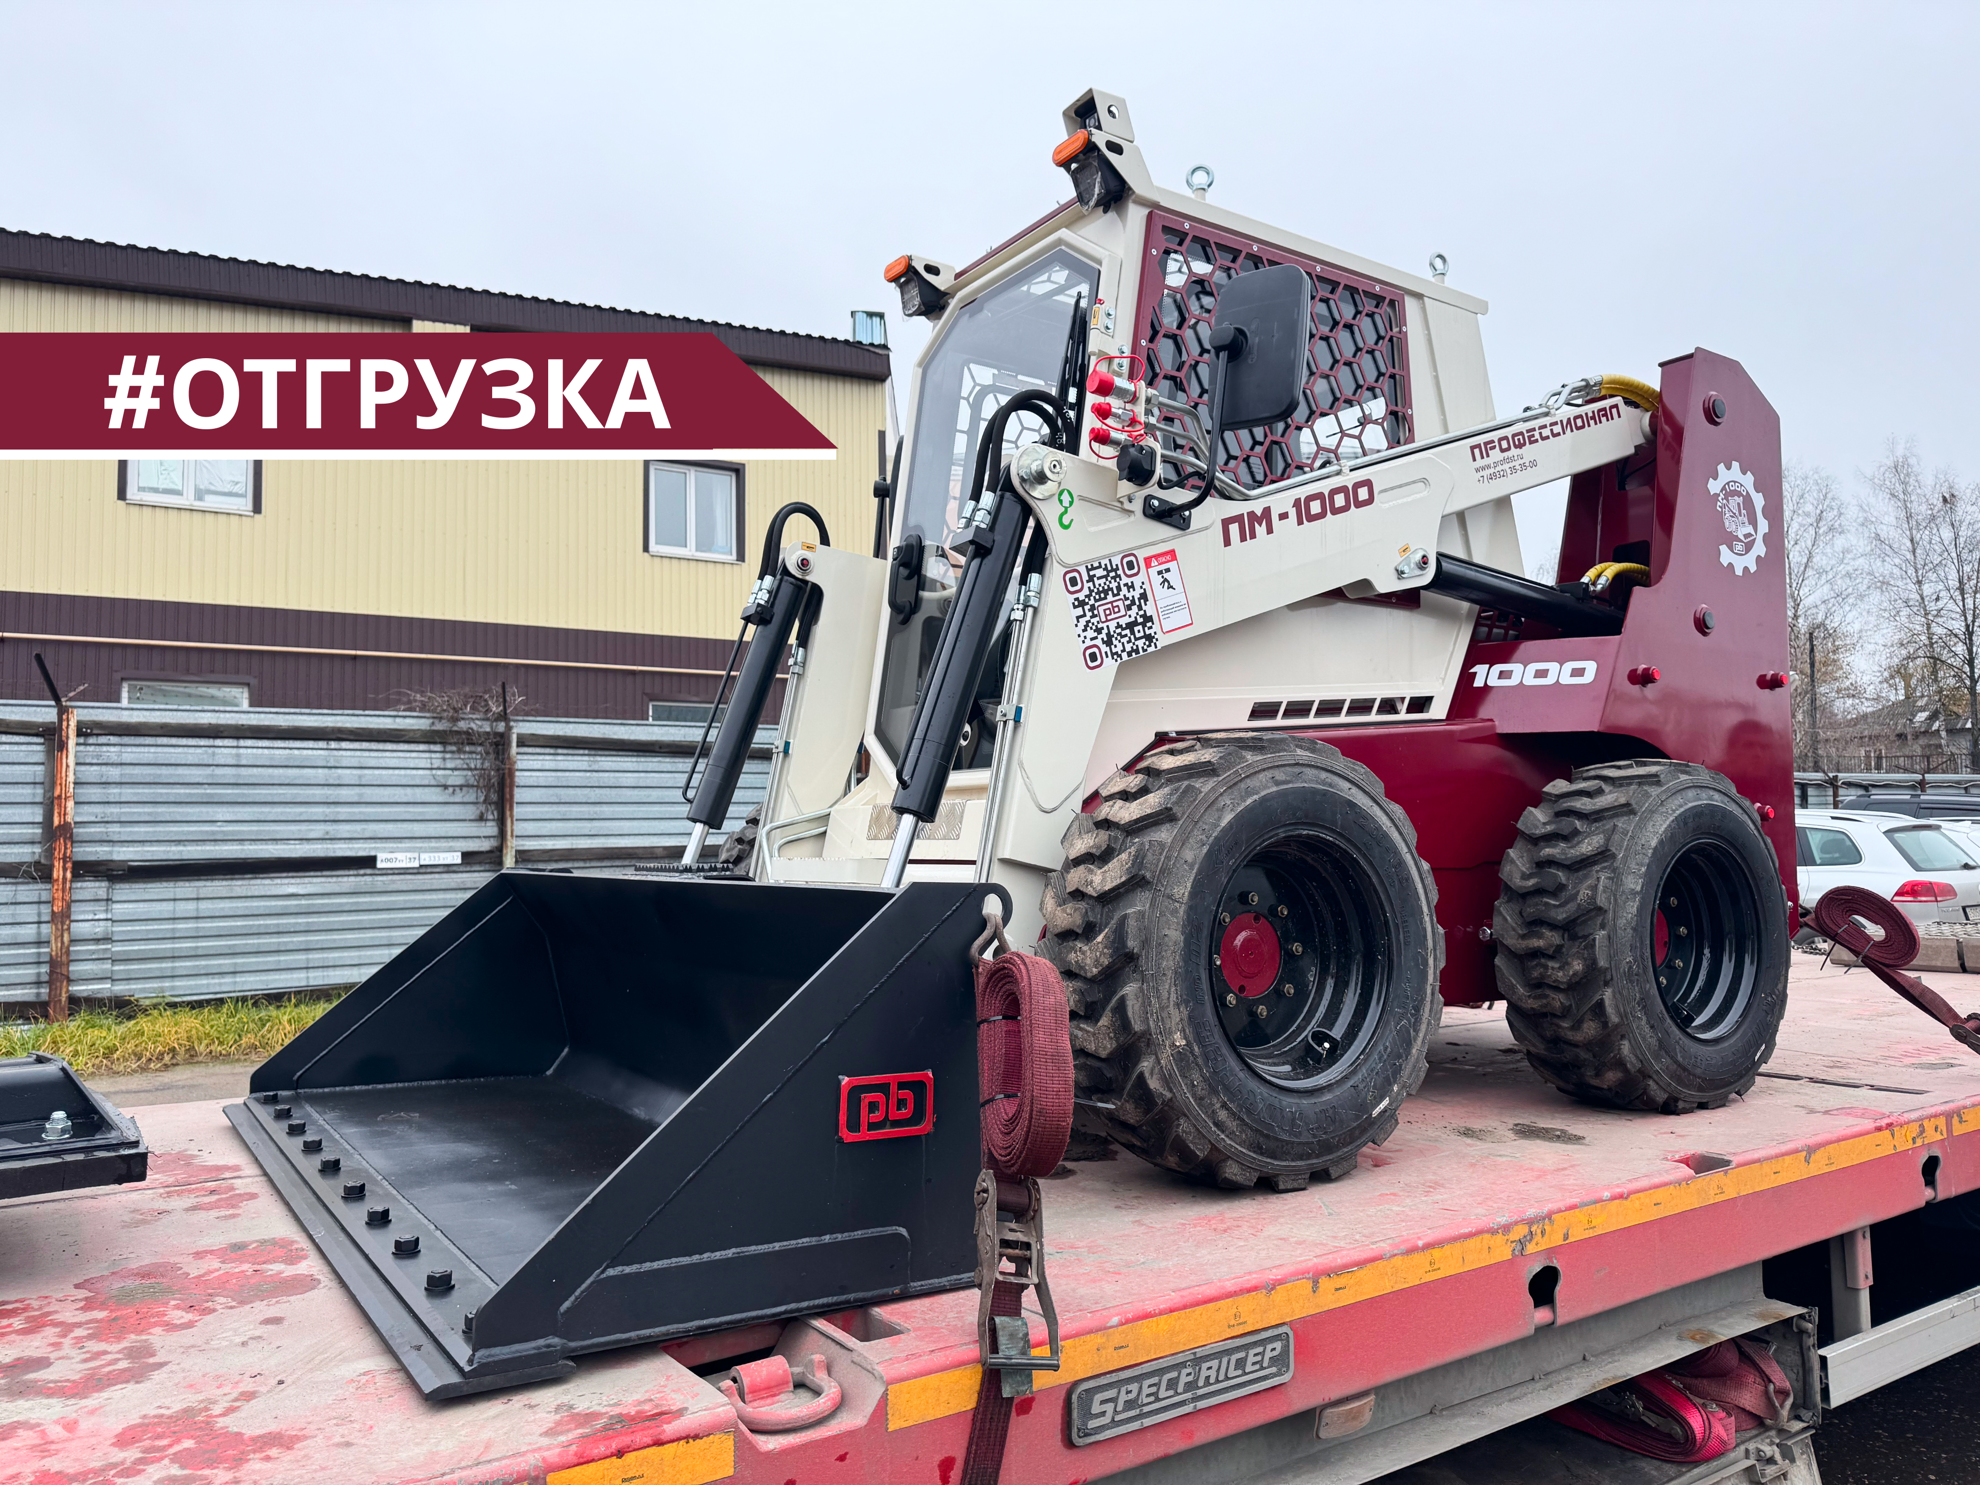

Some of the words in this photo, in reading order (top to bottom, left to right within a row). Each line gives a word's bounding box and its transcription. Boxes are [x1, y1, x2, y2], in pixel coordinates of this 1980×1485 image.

[1474, 453, 1524, 473] www.profdst.ru
[1477, 475, 1485, 484] +7
[1486, 468, 1508, 484] (4932)
[1508, 459, 1538, 475] 35-35-00
[1221, 478, 1375, 548] ПМ-1000
[1469, 660, 1598, 687] 1000
[1087, 1341, 1282, 1430] SPECPRICEP
